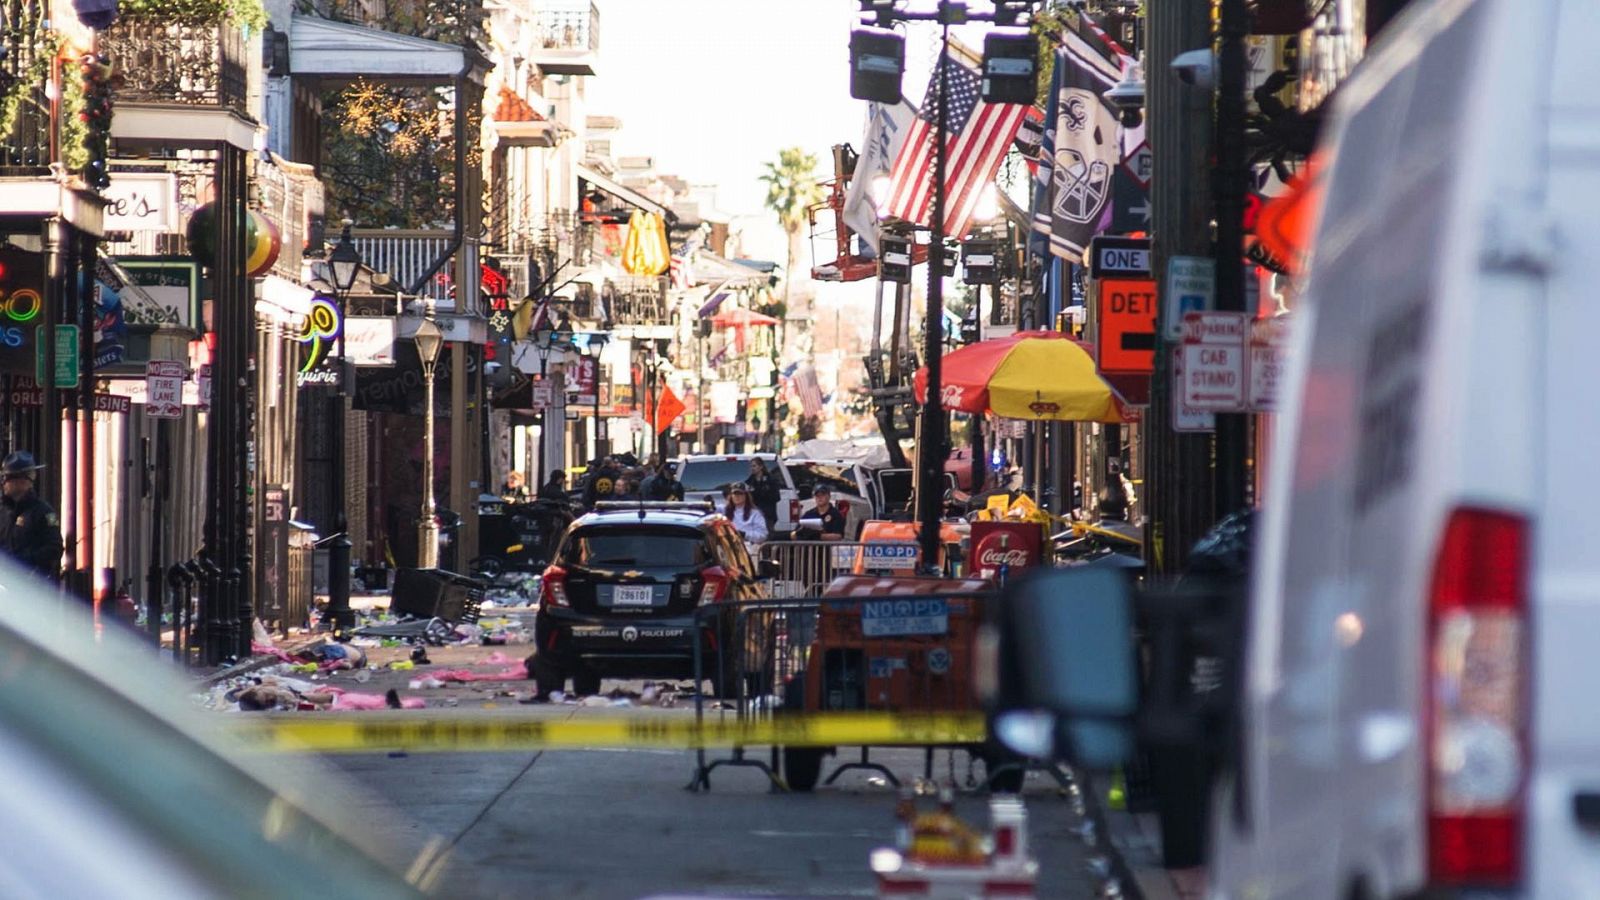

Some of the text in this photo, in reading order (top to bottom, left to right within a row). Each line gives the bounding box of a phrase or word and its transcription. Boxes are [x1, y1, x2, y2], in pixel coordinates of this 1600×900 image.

[1105, 250, 1141, 268] ONE
[1200, 349, 1228, 366] CAB
[155, 379, 175, 390] FIRE
[1191, 371, 1237, 388] STAND
[153, 391, 176, 402] LANE
[641, 629, 663, 638] POLICE
[665, 629, 684, 638] DEPT
